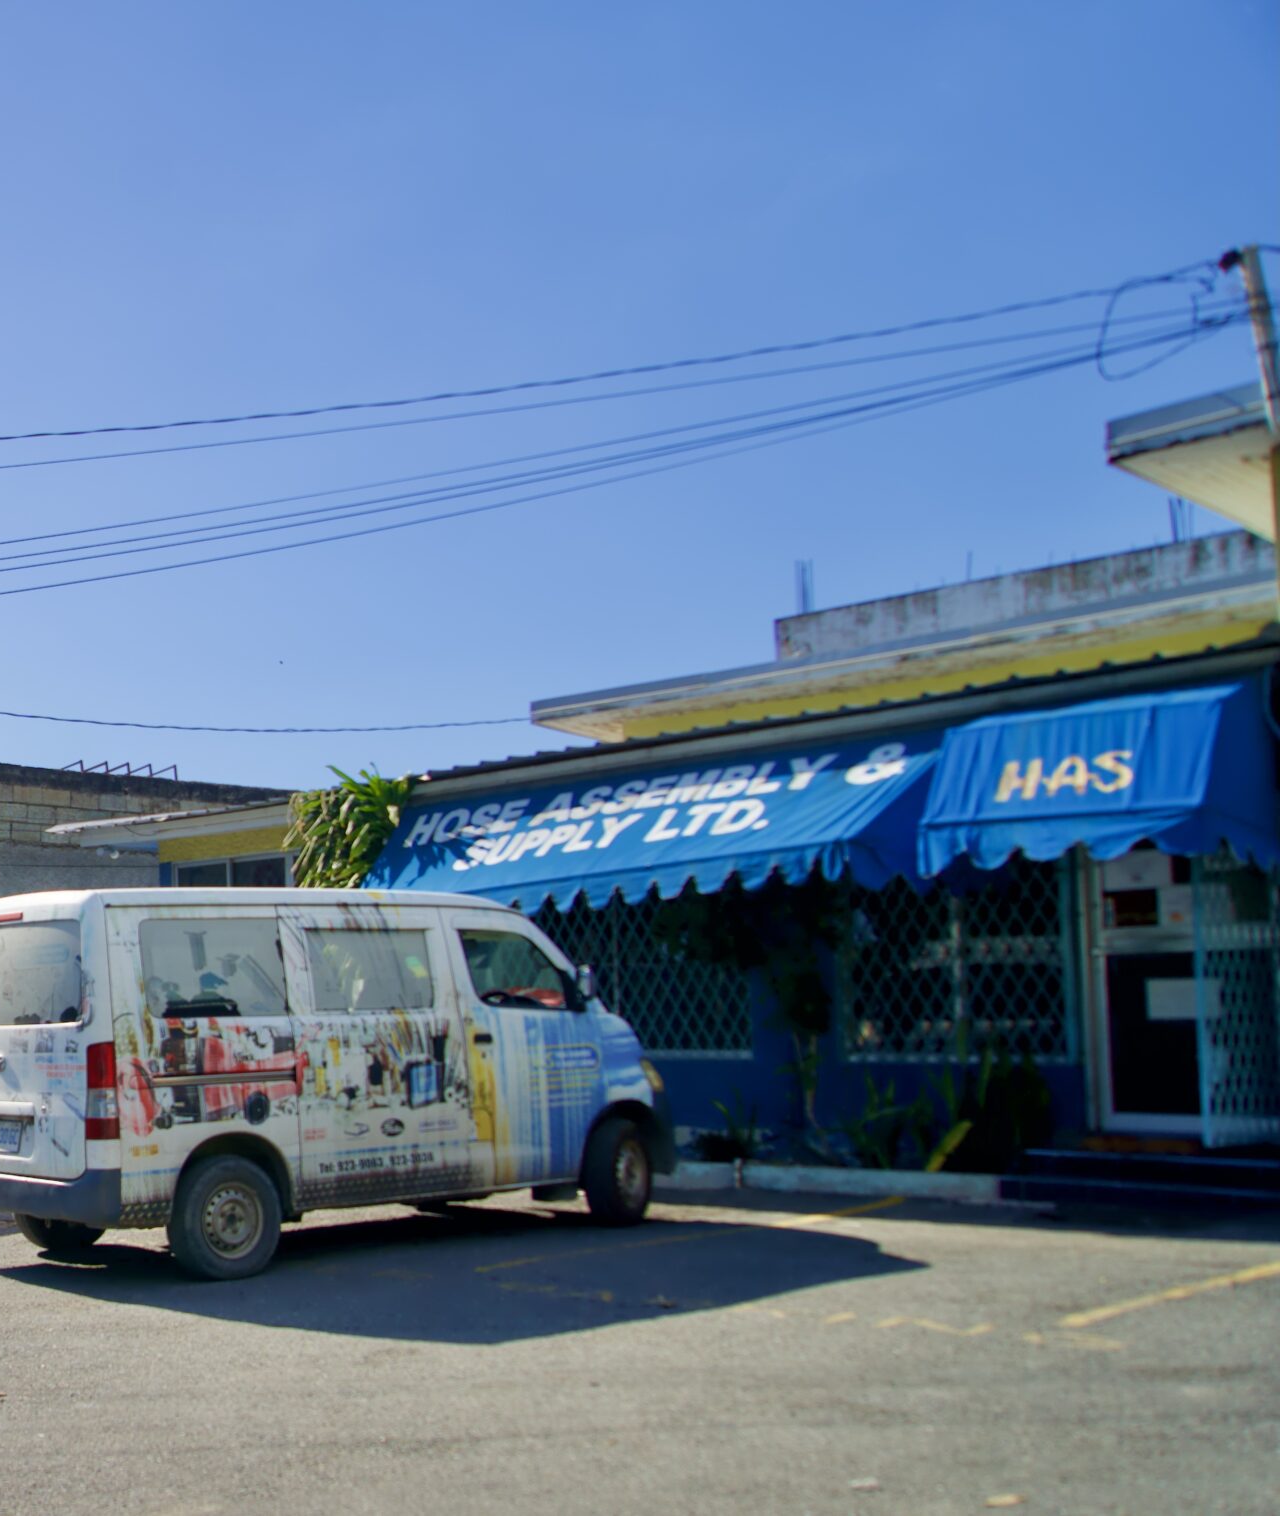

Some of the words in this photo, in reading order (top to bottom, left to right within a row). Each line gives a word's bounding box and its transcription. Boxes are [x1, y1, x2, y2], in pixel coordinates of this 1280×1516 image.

[403, 797, 532, 848] HOSE
[527, 752, 838, 827] ASSEMBLY
[844, 742, 907, 786] &
[991, 748, 1136, 805] HAS
[451, 812, 644, 872] SUPPLY
[643, 798, 770, 843] LTD.
